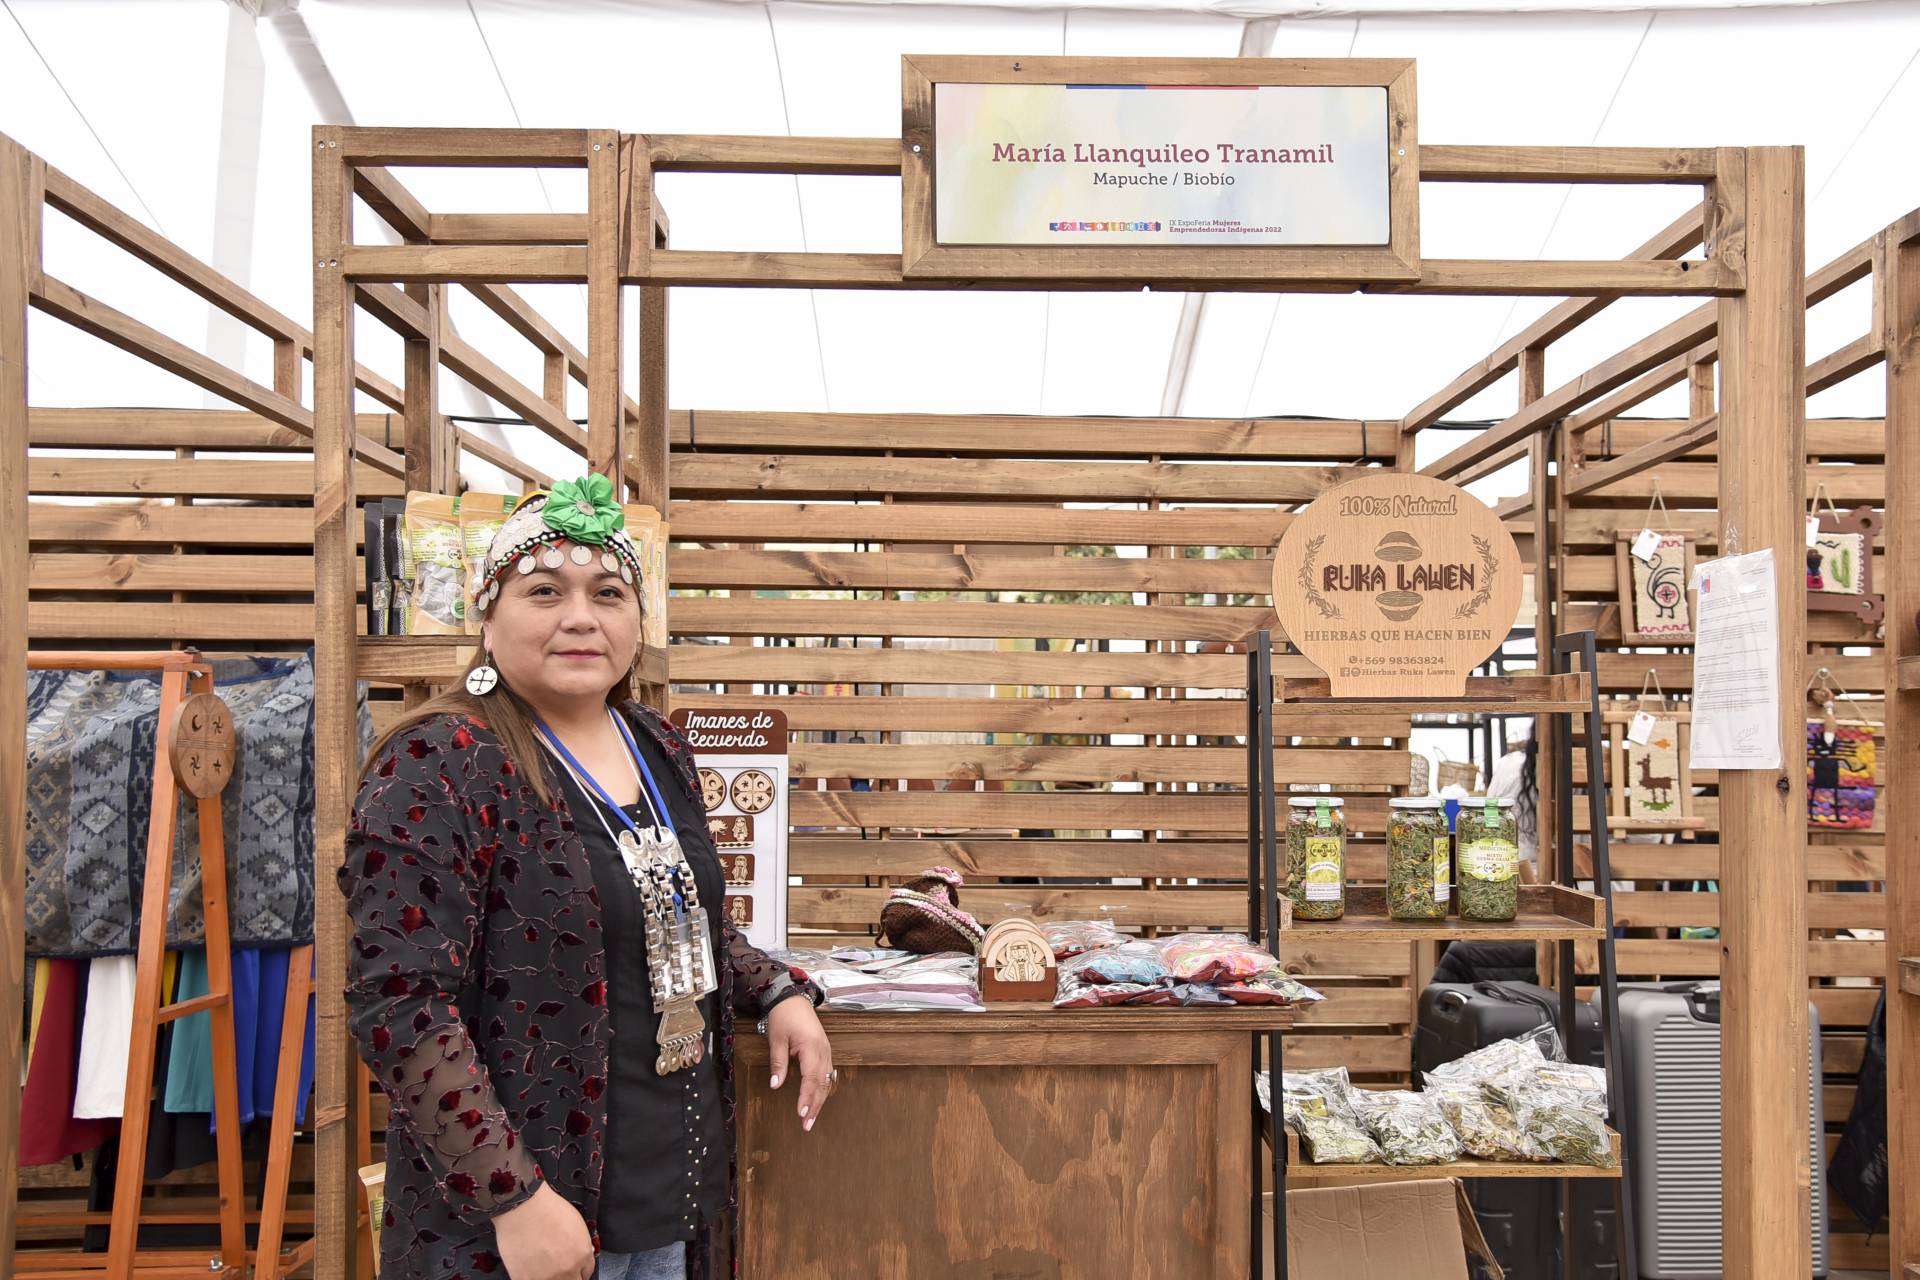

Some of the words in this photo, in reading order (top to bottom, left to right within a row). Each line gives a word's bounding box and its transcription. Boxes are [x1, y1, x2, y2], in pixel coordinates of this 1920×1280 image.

[992, 143, 1066, 163] María
[1073, 143, 1210, 168] Llanquileo
[1216, 144, 1334, 164] Tranamil
[1093, 172, 1168, 188] Mapuche
[1172, 172, 1179, 186] /
[1183, 172, 1235, 186] Biobío
[1340, 496, 1390, 517] 100%
[1393, 495, 1458, 518] Natural
[1323, 564, 1386, 592] RUKA
[1396, 564, 1474, 592] LAWEN
[1304, 630, 1367, 642] HIERBAS
[1370, 630, 1400, 643] QUE
[1404, 630, 1454, 641] HACEN
[1457, 629, 1492, 641] BIEN
[1358, 656, 1386, 665] +569
[1361, 668, 1397, 676] Hierbas
[1400, 668, 1424, 676] Ruka
[1427, 667, 1456, 676] Lawen
[685, 711, 750, 729] Imanes
[752, 711, 774, 729] de
[687, 730, 768, 747] Recuerdo
